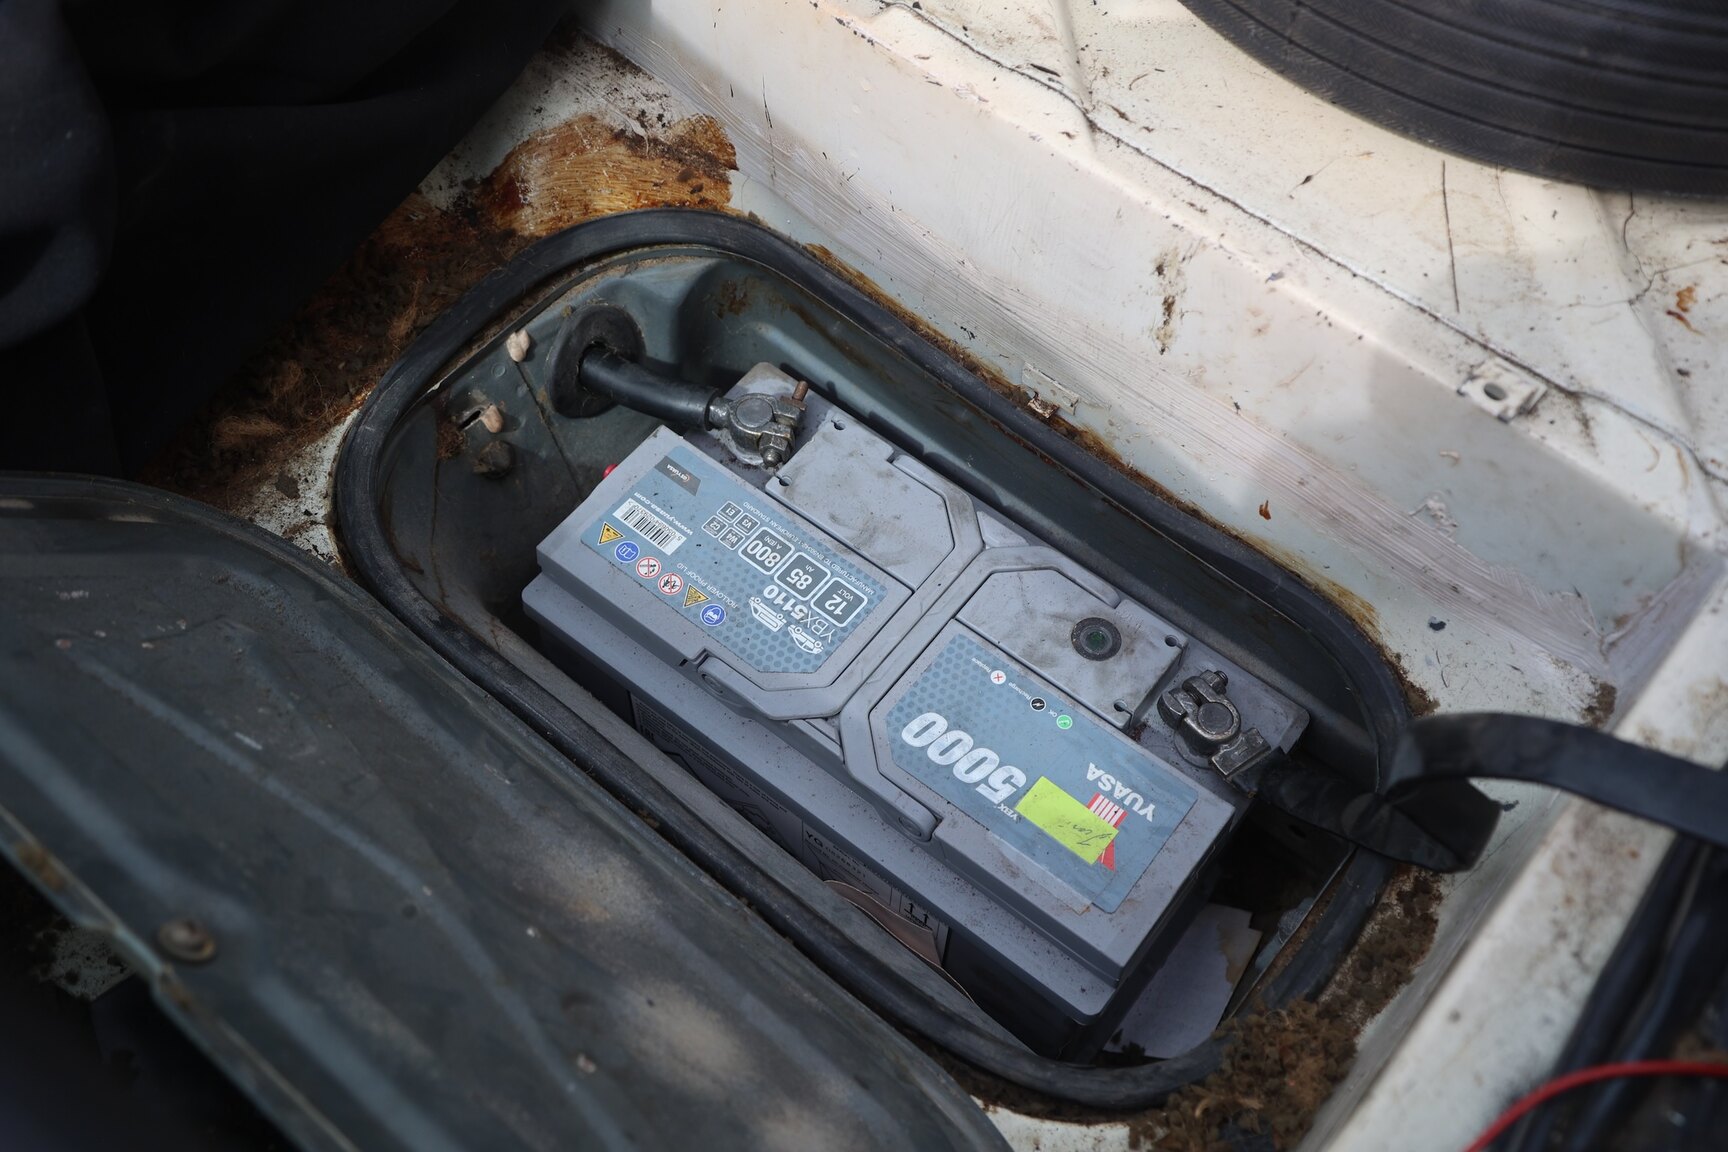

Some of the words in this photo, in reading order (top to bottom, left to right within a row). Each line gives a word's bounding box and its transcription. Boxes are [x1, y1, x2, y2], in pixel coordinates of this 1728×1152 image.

[633, 491, 693, 535] www.yuasa.com
[724, 506, 736, 516] E1
[742, 500, 771, 522] STANDARD
[741, 517, 752, 528] V3
[768, 519, 799, 542] EUROPEAN
[725, 531, 739, 543] W4
[744, 537, 782, 568] 800
[675, 561, 688, 571] LID
[804, 563, 815, 573] Ah
[685, 568, 708, 586] PROOF
[785, 566, 814, 591] 85
[829, 562, 875, 595] MANUFACTURED
[705, 583, 738, 608] ROLLOVER
[836, 587, 854, 601] VOLT
[760, 582, 836, 643] YBX5110
[822, 593, 848, 617] 12
[970, 656, 991, 673] Replace
[1007, 680, 1032, 700] Recharge
[1047, 708, 1058, 718] OK
[901, 712, 1027, 804] 5000
[1085, 761, 1157, 822] YUASA
[995, 802, 1017, 820] YBX
